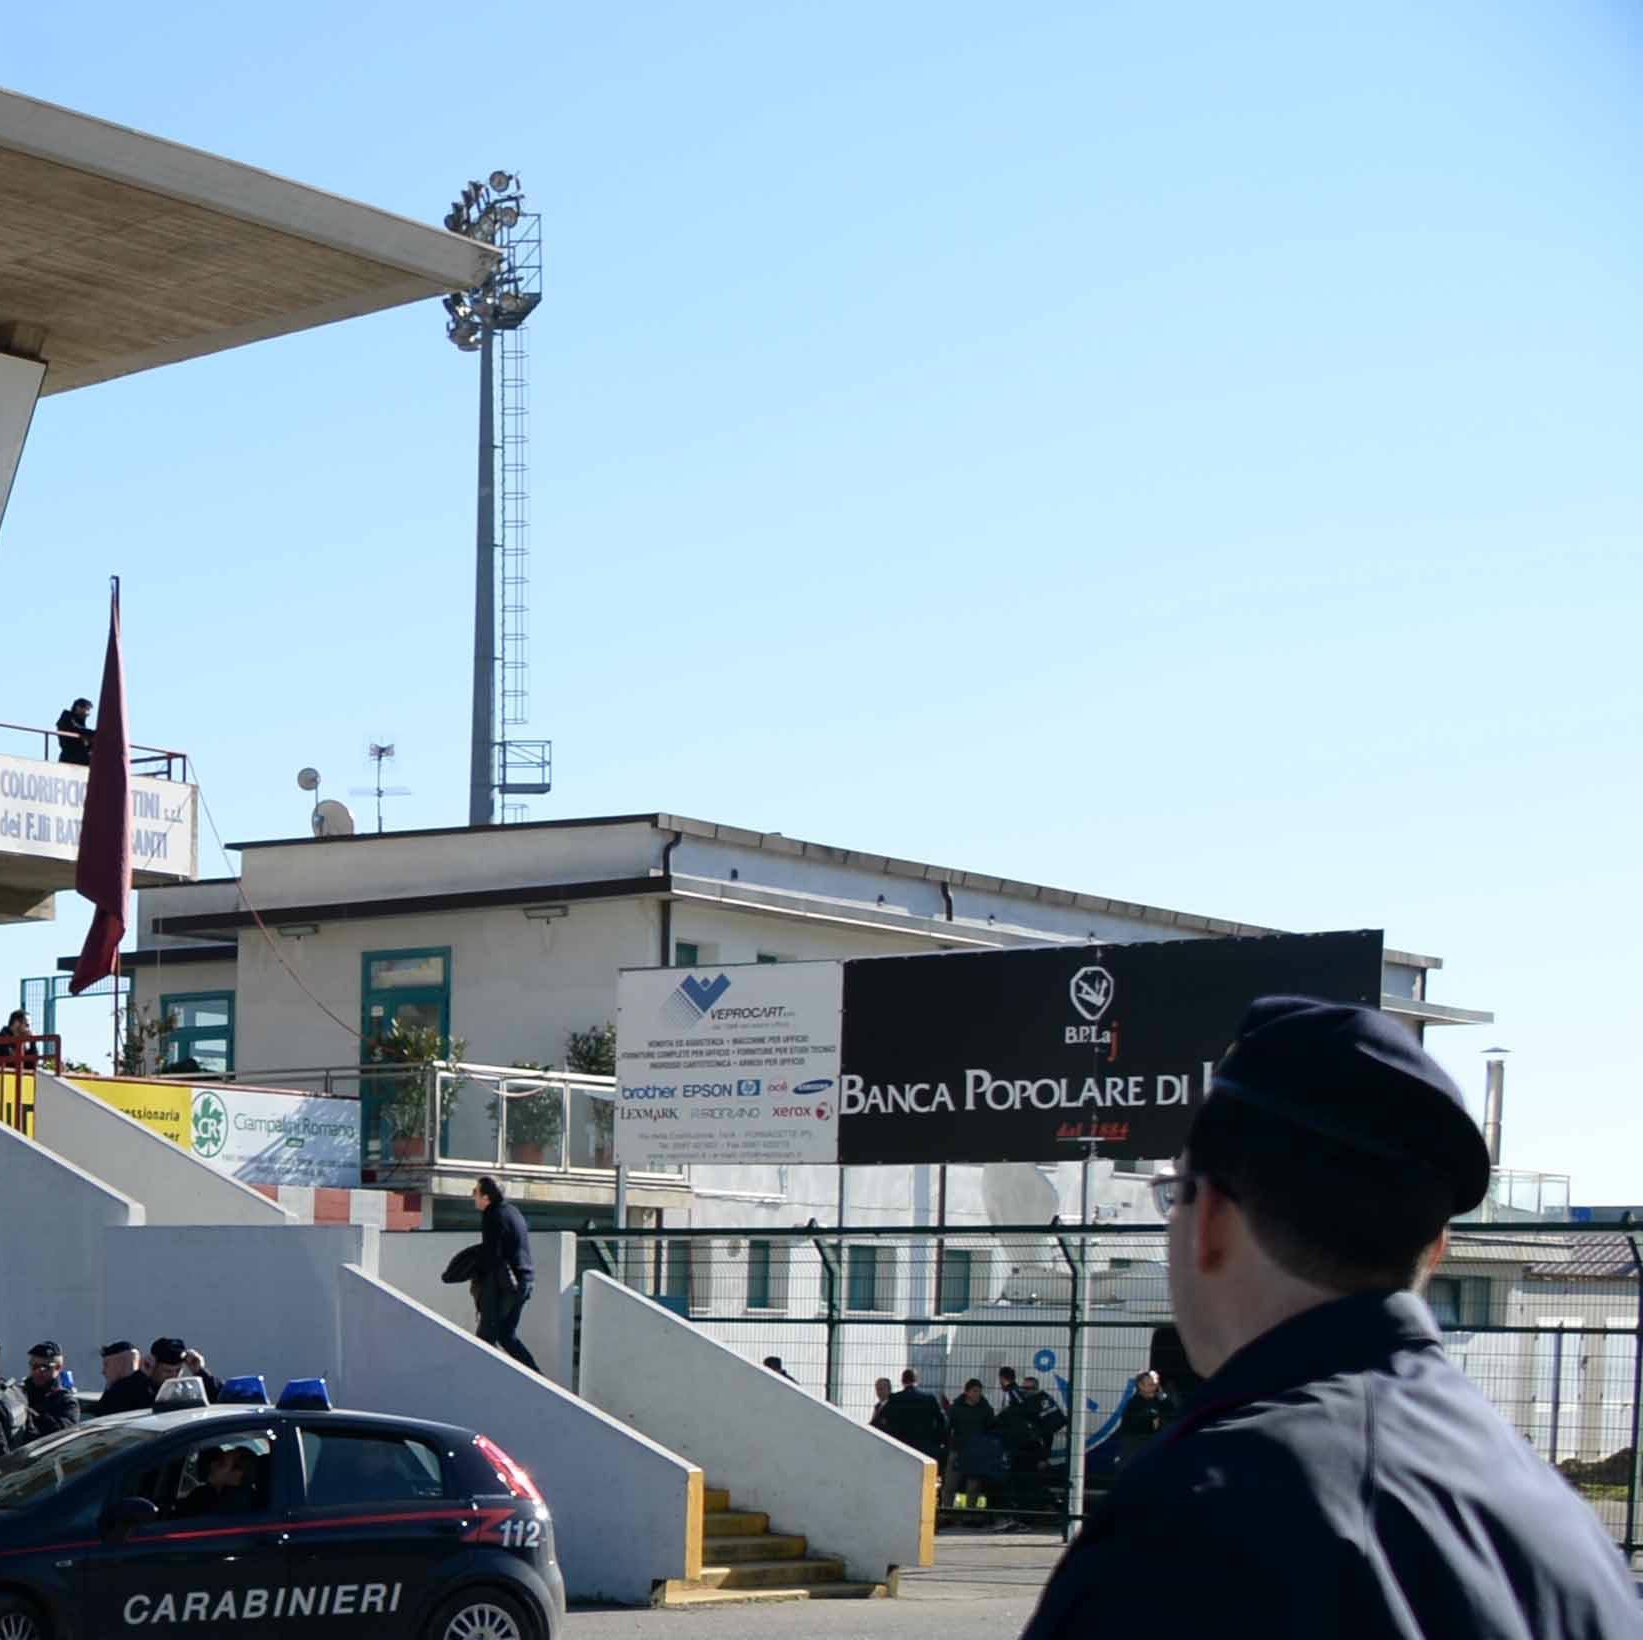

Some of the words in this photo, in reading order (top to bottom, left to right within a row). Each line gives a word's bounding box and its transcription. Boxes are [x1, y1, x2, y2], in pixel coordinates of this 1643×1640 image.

[0, 809, 21, 840] dei
[711, 1006, 785, 1021] VEPROCART
[622, 1085, 677, 1100] brother
[683, 1083, 732, 1098] EPSON
[840, 1075, 955, 1116] BANCA
[965, 1068, 1147, 1112] POPOLARE
[1155, 1074, 1190, 1106] DI
[620, 1106, 681, 1122] LEXMARK
[772, 1105, 811, 1118] xerox
[303, 1118, 355, 1139] Romano
[500, 1518, 541, 1550] 112
[123, 1583, 402, 1626] CARABINIERI
